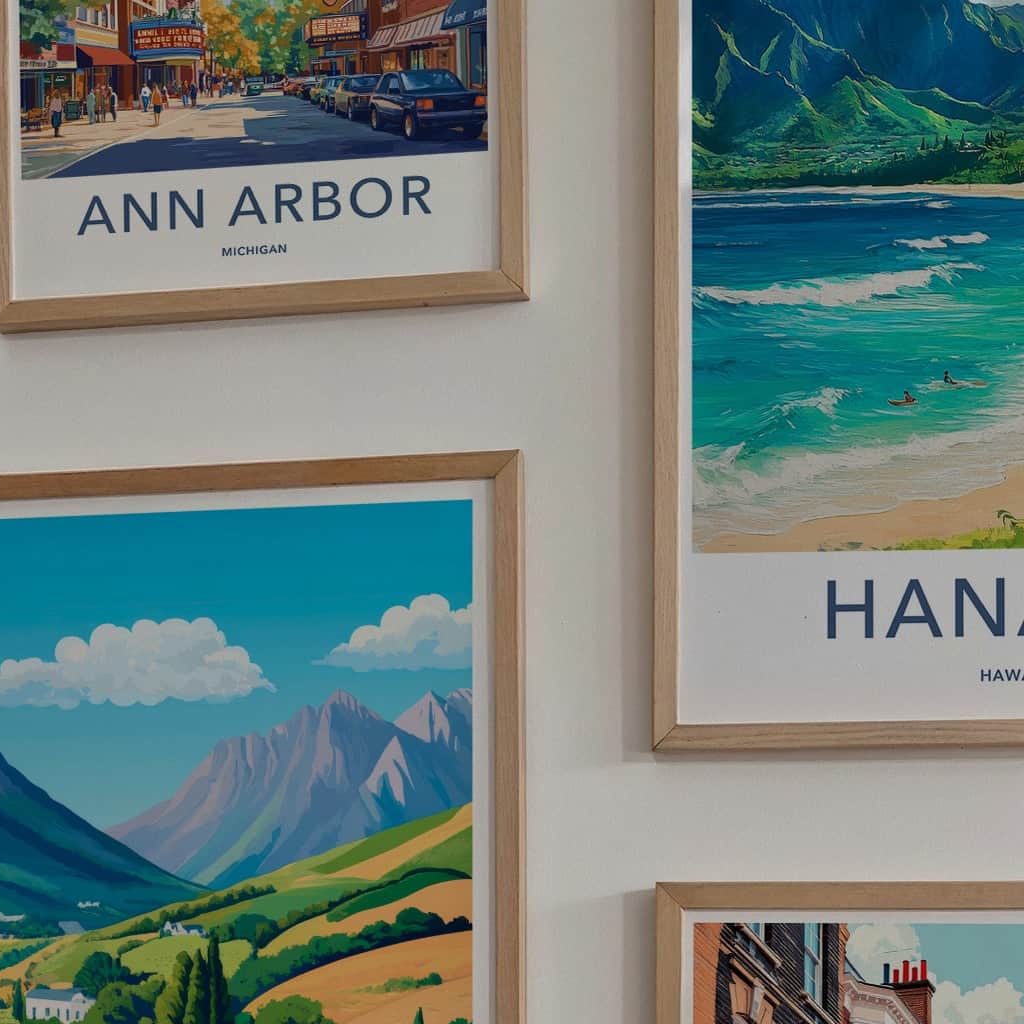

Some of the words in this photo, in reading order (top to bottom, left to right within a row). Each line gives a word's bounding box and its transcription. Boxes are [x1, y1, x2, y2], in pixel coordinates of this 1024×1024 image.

[77, 189, 205, 236] ANN
[228, 175, 432, 227] ARBOR
[221, 243, 288, 257] MICHIGAN
[826, 577, 1024, 640] HAN
[980, 669, 1024, 683] HAW
